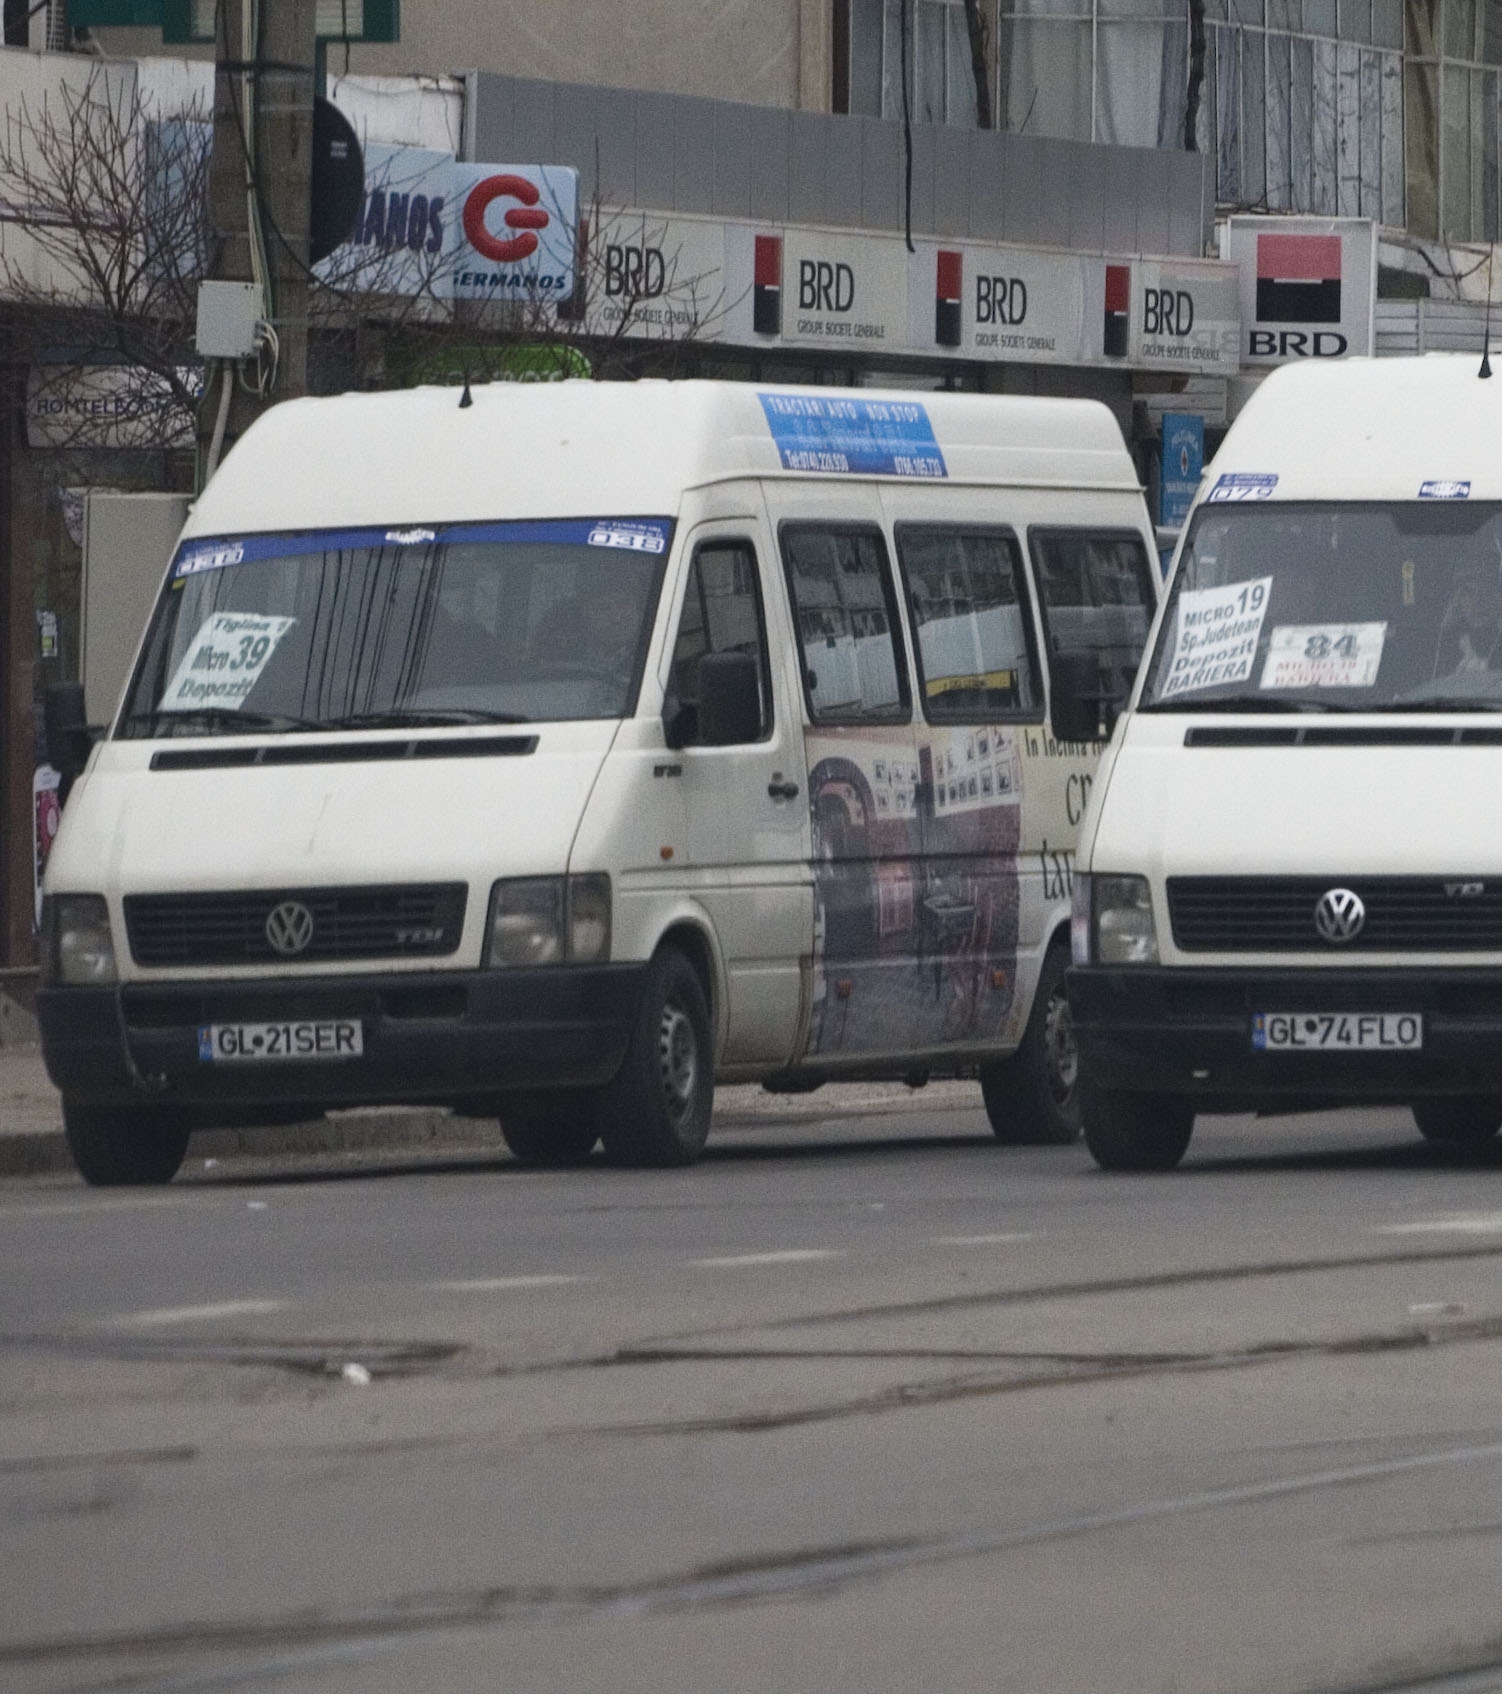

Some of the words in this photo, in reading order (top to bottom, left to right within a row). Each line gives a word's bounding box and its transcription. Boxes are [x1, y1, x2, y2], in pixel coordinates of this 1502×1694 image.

[354, 189, 444, 252] ANOS
[604, 244, 666, 298] BRD
[799, 259, 855, 312] BRD
[976, 275, 1028, 325] BRD
[1143, 288, 1195, 336] BRD
[1250, 331, 1348, 357] BRD
[768, 397, 826, 417] TRACTARI
[827, 400, 857, 420] AUTO
[866, 403, 891, 421] NON
[891, 405, 919, 424] STOP
[1184, 603, 1235, 627] MICRO
[1238, 584, 1266, 616] 19
[229, 635, 271, 670] 39
[1174, 639, 1254, 673] Depozit
[1303, 634, 1359, 660] 84
[176, 677, 253, 703] Depozit
[1167, 660, 1248, 693] BARIERA
